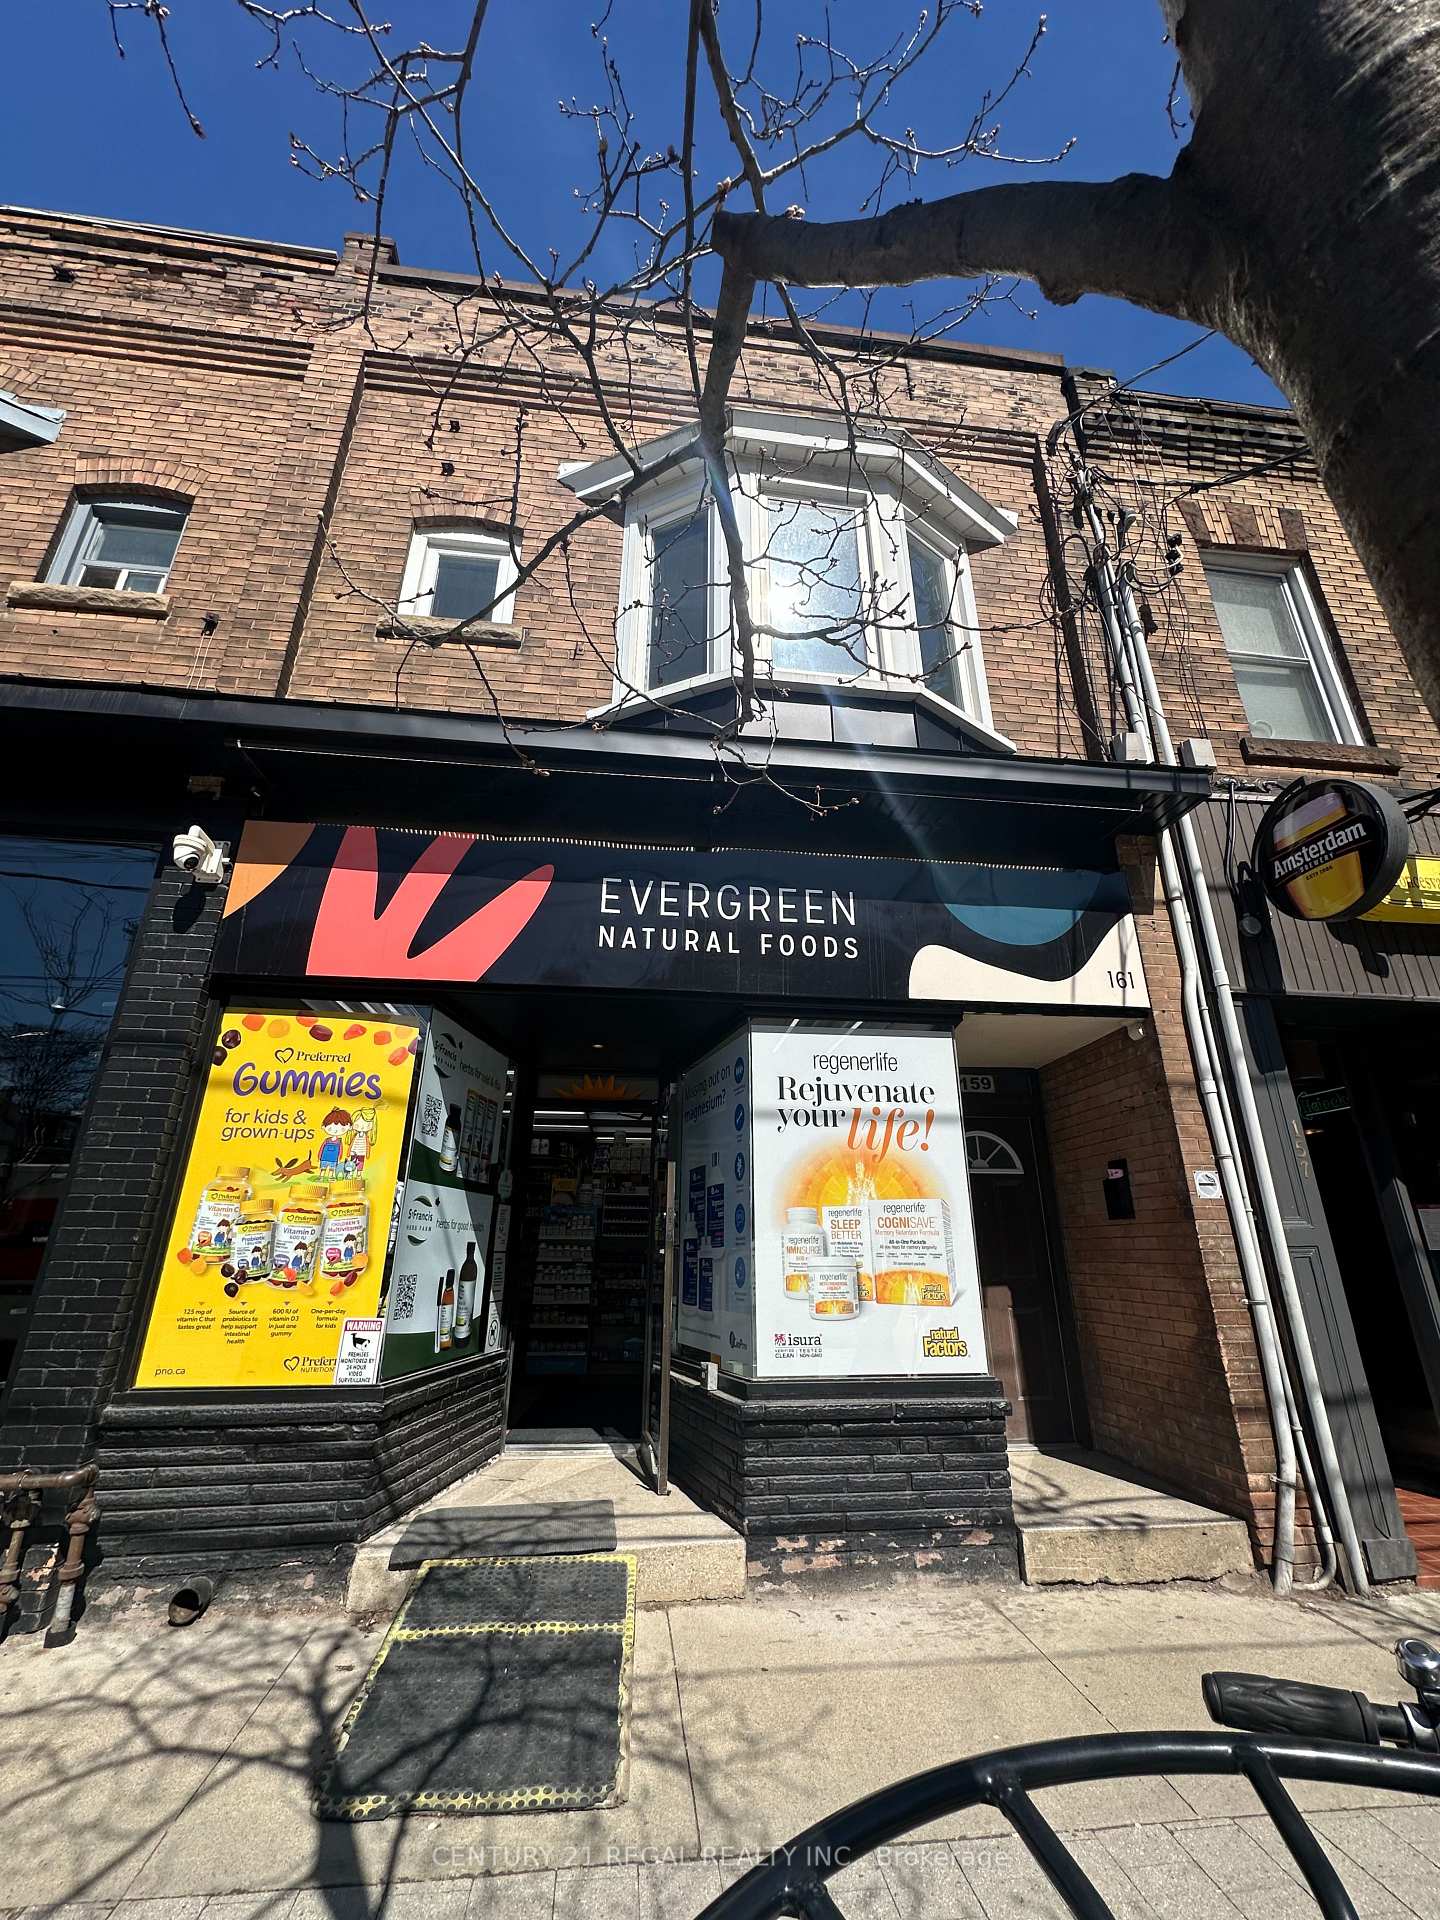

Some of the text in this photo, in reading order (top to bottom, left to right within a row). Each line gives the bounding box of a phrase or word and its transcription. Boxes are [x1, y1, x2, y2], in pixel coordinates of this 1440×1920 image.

[1274, 822, 1367, 879] Amsterdam
[600, 877, 856, 926] EVERGREEN
[598, 925, 859, 959] NATURAL FOODS
[1107, 970, 1135, 989] 161
[296, 1050, 351, 1063] Preferred
[813, 1052, 898, 1075] regenerlife
[232, 1062, 382, 1100] Gummies
[960, 1076, 992, 1090] 159
[776, 1075, 935, 1107] Rejuvenate
[225, 1108, 307, 1125] for kids &
[221, 1126, 315, 1143] grown-ups
[776, 1106, 935, 1164] your life!
[828, 1208, 863, 1218] regenerlife
[883, 1202, 926, 1215] regenerlife
[830, 1219, 861, 1230] SLEEP
[877, 1216, 935, 1229] COGNISAVE
[283, 1227, 309, 1235] Vitamin
[831, 1230, 862, 1240] BETTER
[310, 1308, 347, 1316] One-per-day
[346, 1320, 382, 1331] WARNING
[788, 1333, 822, 1346] isura
[930, 1327, 960, 1341] natural
[922, 1336, 968, 1357] Factors
[154, 1368, 186, 1377] pno.ca
